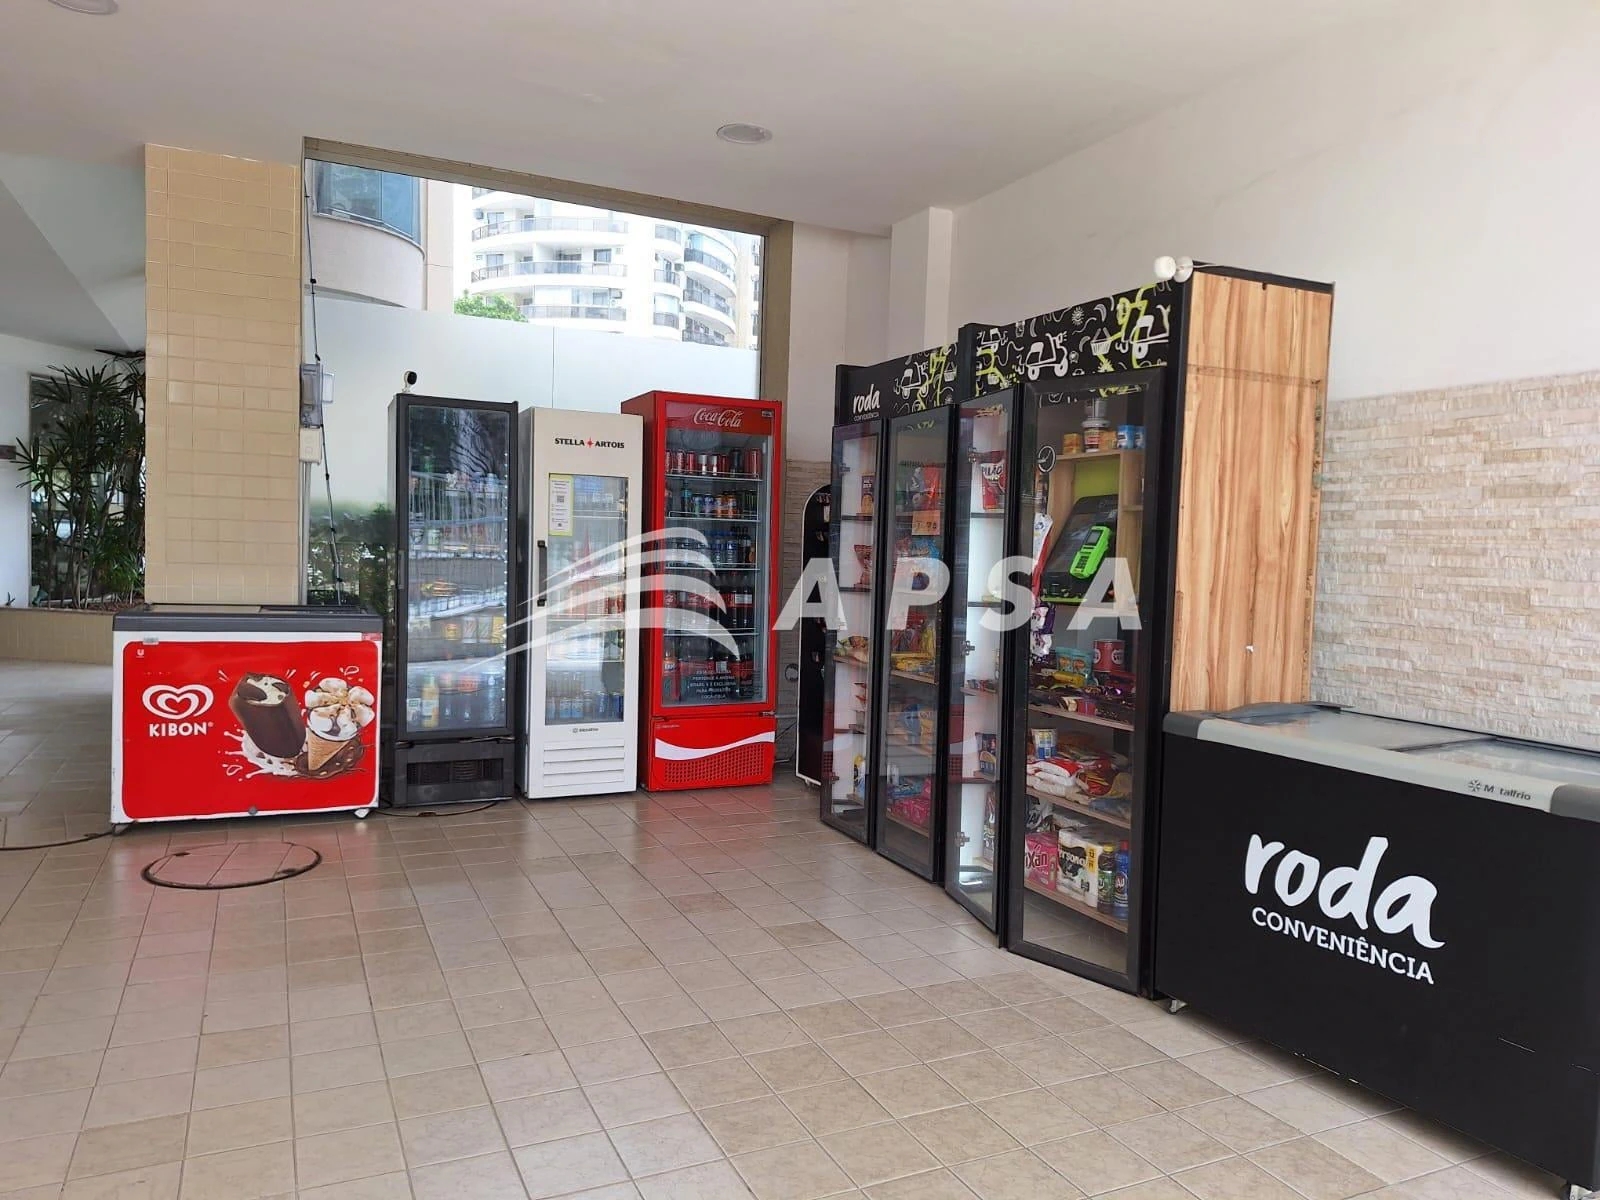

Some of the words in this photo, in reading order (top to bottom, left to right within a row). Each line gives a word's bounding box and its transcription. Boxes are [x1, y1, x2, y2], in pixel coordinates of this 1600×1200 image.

[853, 383, 880, 414] roda
[554, 437, 585, 447] STELLA
[594, 440, 625, 449] ARTOIS
[1483, 784, 1531, 801] Mtalfrio
[1244, 833, 1446, 949] roda
[1251, 906, 1435, 985] CONVENIÊNCIA
